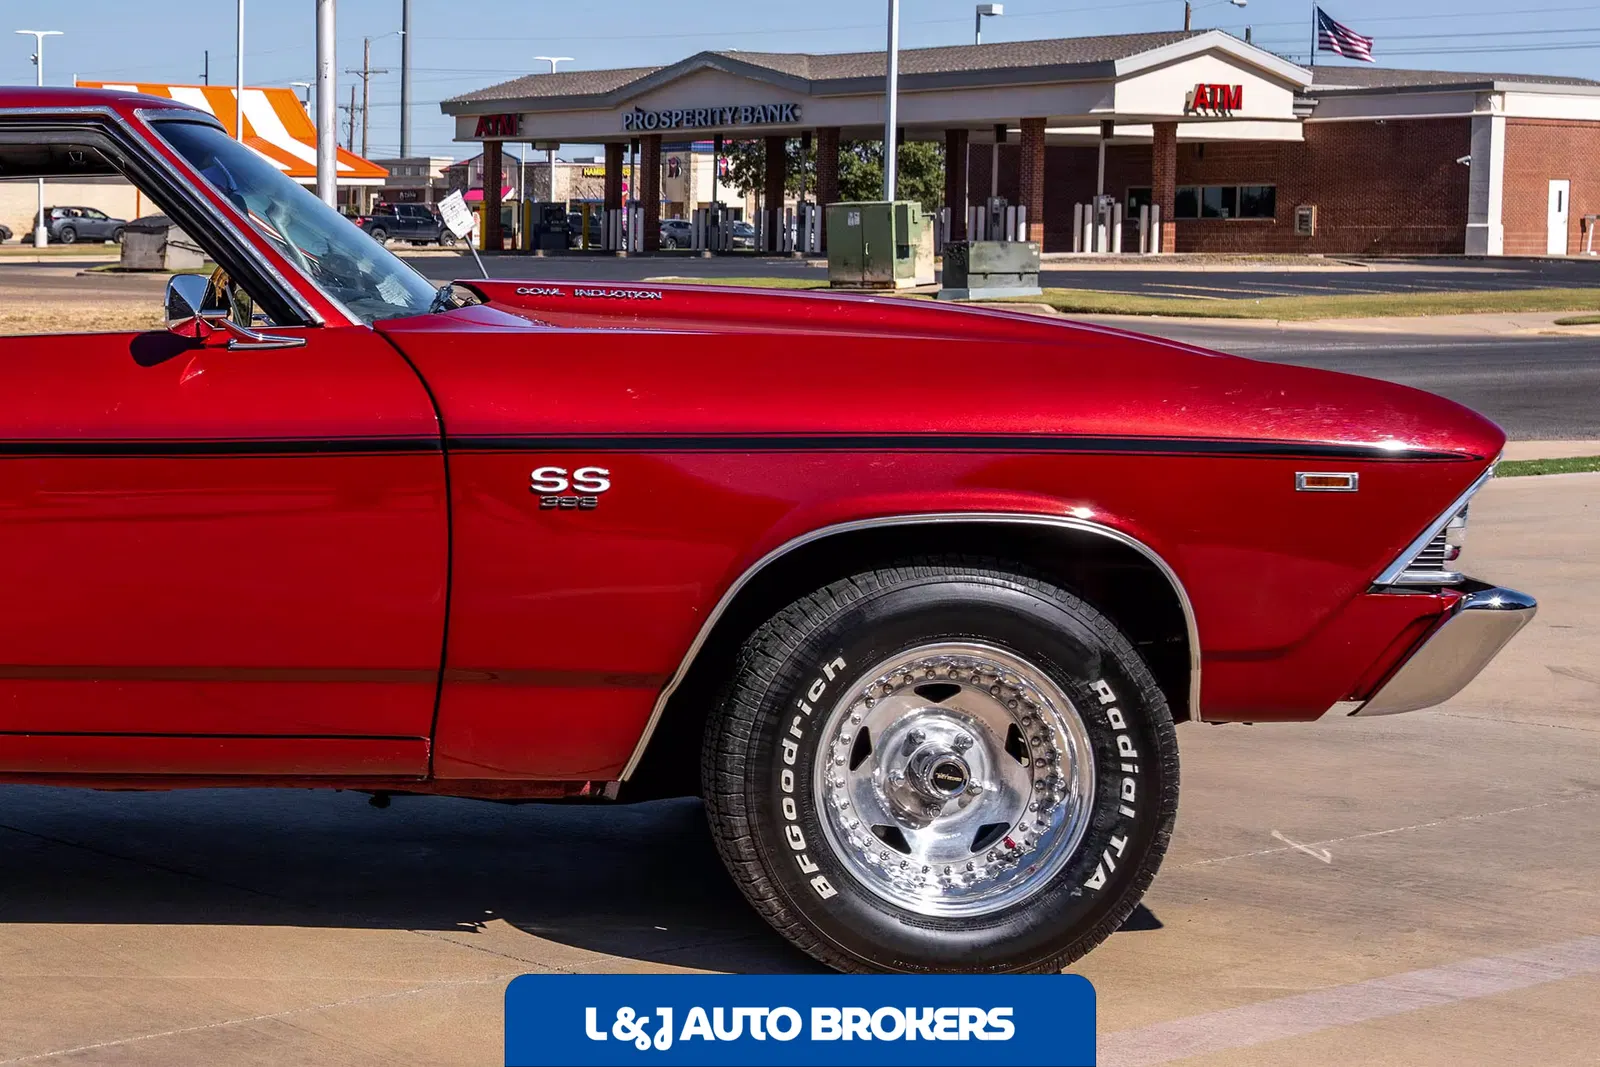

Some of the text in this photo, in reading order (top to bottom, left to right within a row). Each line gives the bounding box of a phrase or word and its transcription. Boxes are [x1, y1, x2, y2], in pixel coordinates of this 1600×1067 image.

[1193, 84, 1242, 110] ATM
[475, 114, 518, 137] ATM
[622, 104, 797, 130] PROSPERITY BANK
[517, 287, 662, 299] COWL INDUCTION
[531, 466, 611, 492] SS
[781, 656, 847, 900] BFGoodrich
[1084, 679, 1139, 890] Radial T/A
